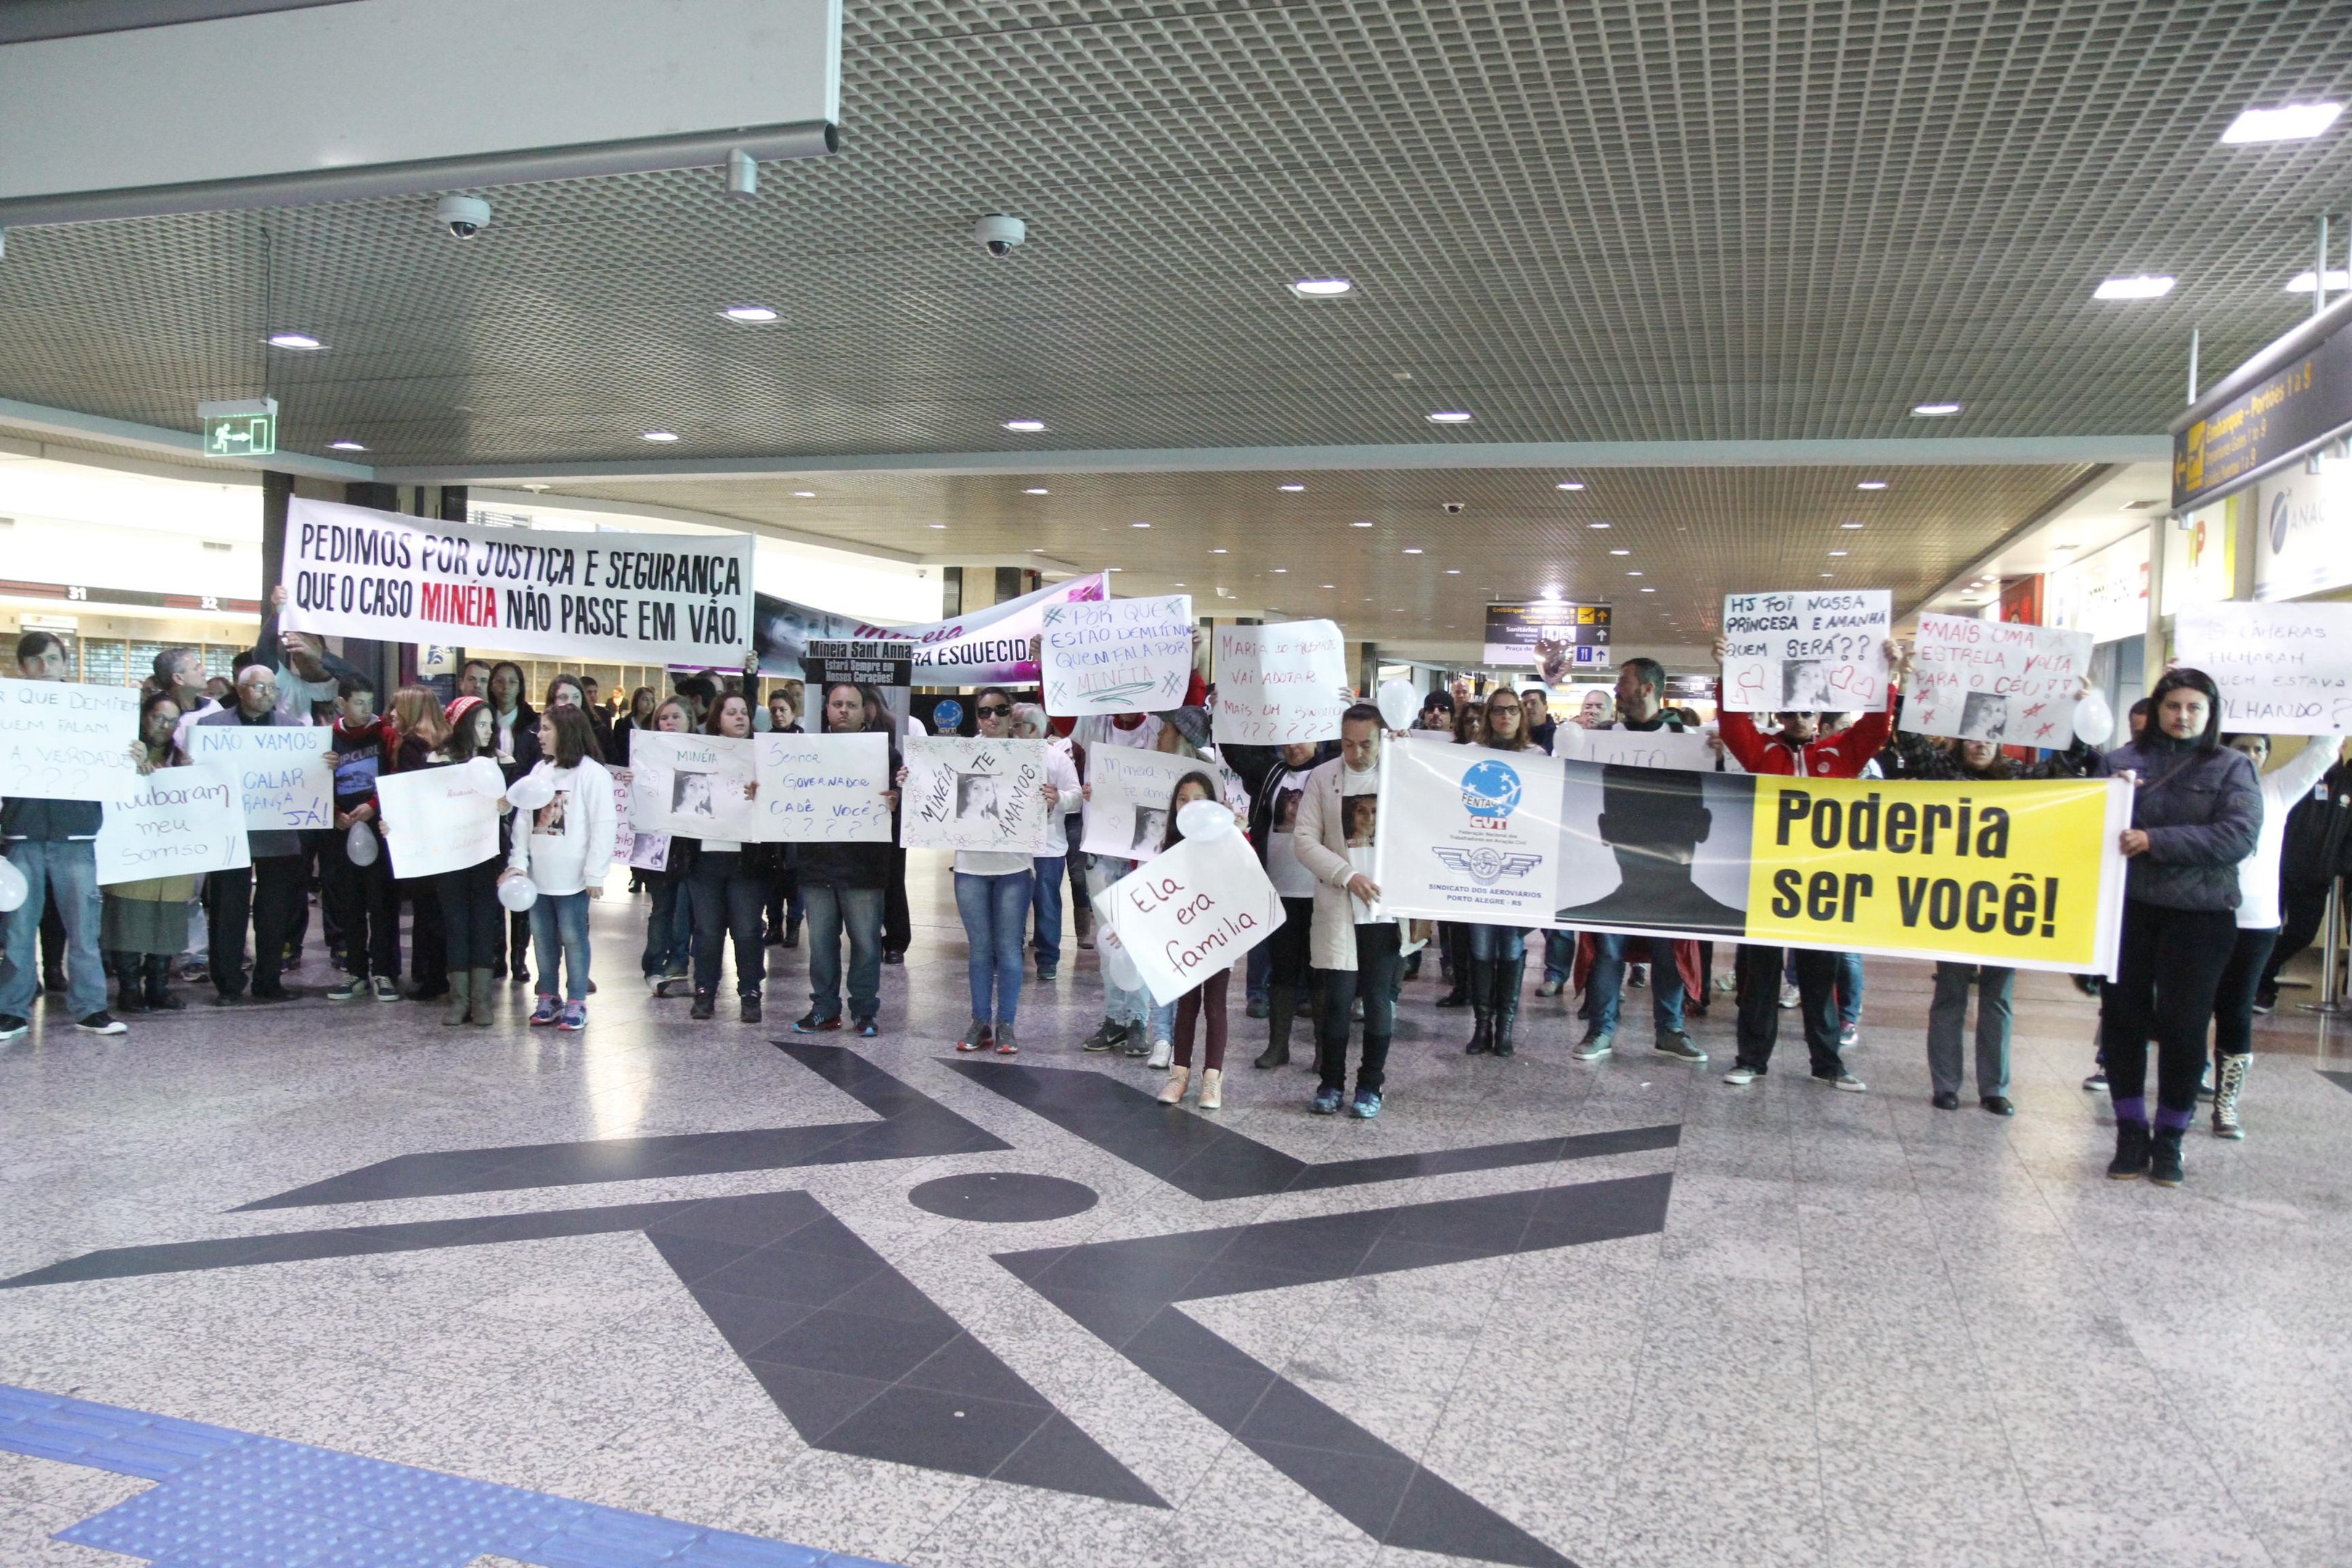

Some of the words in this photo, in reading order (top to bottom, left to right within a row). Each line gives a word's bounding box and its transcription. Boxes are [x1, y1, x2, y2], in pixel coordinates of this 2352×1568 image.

[2290, 498, 2327, 533] ANAC
[301, 523, 412, 569] PEDIMOS
[422, 535, 470, 575] POR
[477, 541, 573, 587] JUSTIÇA
[584, 550, 599, 587] E
[606, 550, 741, 597] SEGURANÇA
[68, 586, 86, 600] 31
[202, 597, 217, 609] 32
[297, 571, 336, 612] QUE
[341, 575, 354, 613] O
[360, 576, 412, 618] CASO
[420, 580, 497, 628] MINÉIA
[507, 585, 551, 632] NÃO
[561, 594, 628, 638] PASSE
[639, 600, 675, 640] EM
[688, 599, 742, 645] VÃO.
[1731, 597, 1757, 613] HJ
[1807, 595, 1866, 611] NOSSA
[1069, 604, 1112, 625] POR
[1124, 602, 1162, 622] QUE
[1812, 616, 1823, 631] E
[1825, 609, 1887, 629] AMANHÃ
[1051, 625, 1110, 648] ESTÃO
[1991, 627, 2034, 649] UMA
[851, 641, 878, 658] Sant
[882, 642, 912, 658] Anna
[1112, 644, 1153, 662] FALA
[1155, 641, 1188, 656] POR
[1726, 642, 1768, 658] QUEM
[825, 659, 849, 671] Estará
[850, 660, 881, 673] Sempre
[882, 663, 895, 671] em
[1922, 645, 2006, 669] ESTRELA
[2022, 653, 2073, 674] VOLTA
[825, 671, 852, 682] Nossos
[1914, 669, 1959, 688] PARA
[1969, 674, 1985, 688] O
[2220, 675, 2255, 686] UEM
[18, 688, 58, 704] QUE
[1263, 703, 1281, 716] UM
[0, 720, 44, 731] UEM
[58, 719, 110, 733] FALAM
[203, 728, 242, 751] NÃO
[256, 731, 317, 750] VAMOS
[11, 745, 21, 761] A
[36, 746, 132, 769] VERDADE
[677, 748, 718, 762] MINÉIA
[971, 751, 996, 772] TE
[243, 767, 305, 791] CALAR
[783, 773, 870, 791] GOVERNADOR
[770, 798, 814, 814] CADÊ
[136, 819, 191, 836] meu
[1470, 815, 1507, 830] CUT
[1776, 789, 2010, 859] Poderia
[1130, 878, 1185, 913] Ela
[1429, 883, 1469, 893] SINDICATO
[1490, 889, 1542, 899] AEROVIÁRIOS
[1177, 893, 1215, 925] era
[1474, 897, 1505, 905] ALEGRE
[1771, 868, 1873, 923] ser
[1898, 873, 2059, 938] você!
